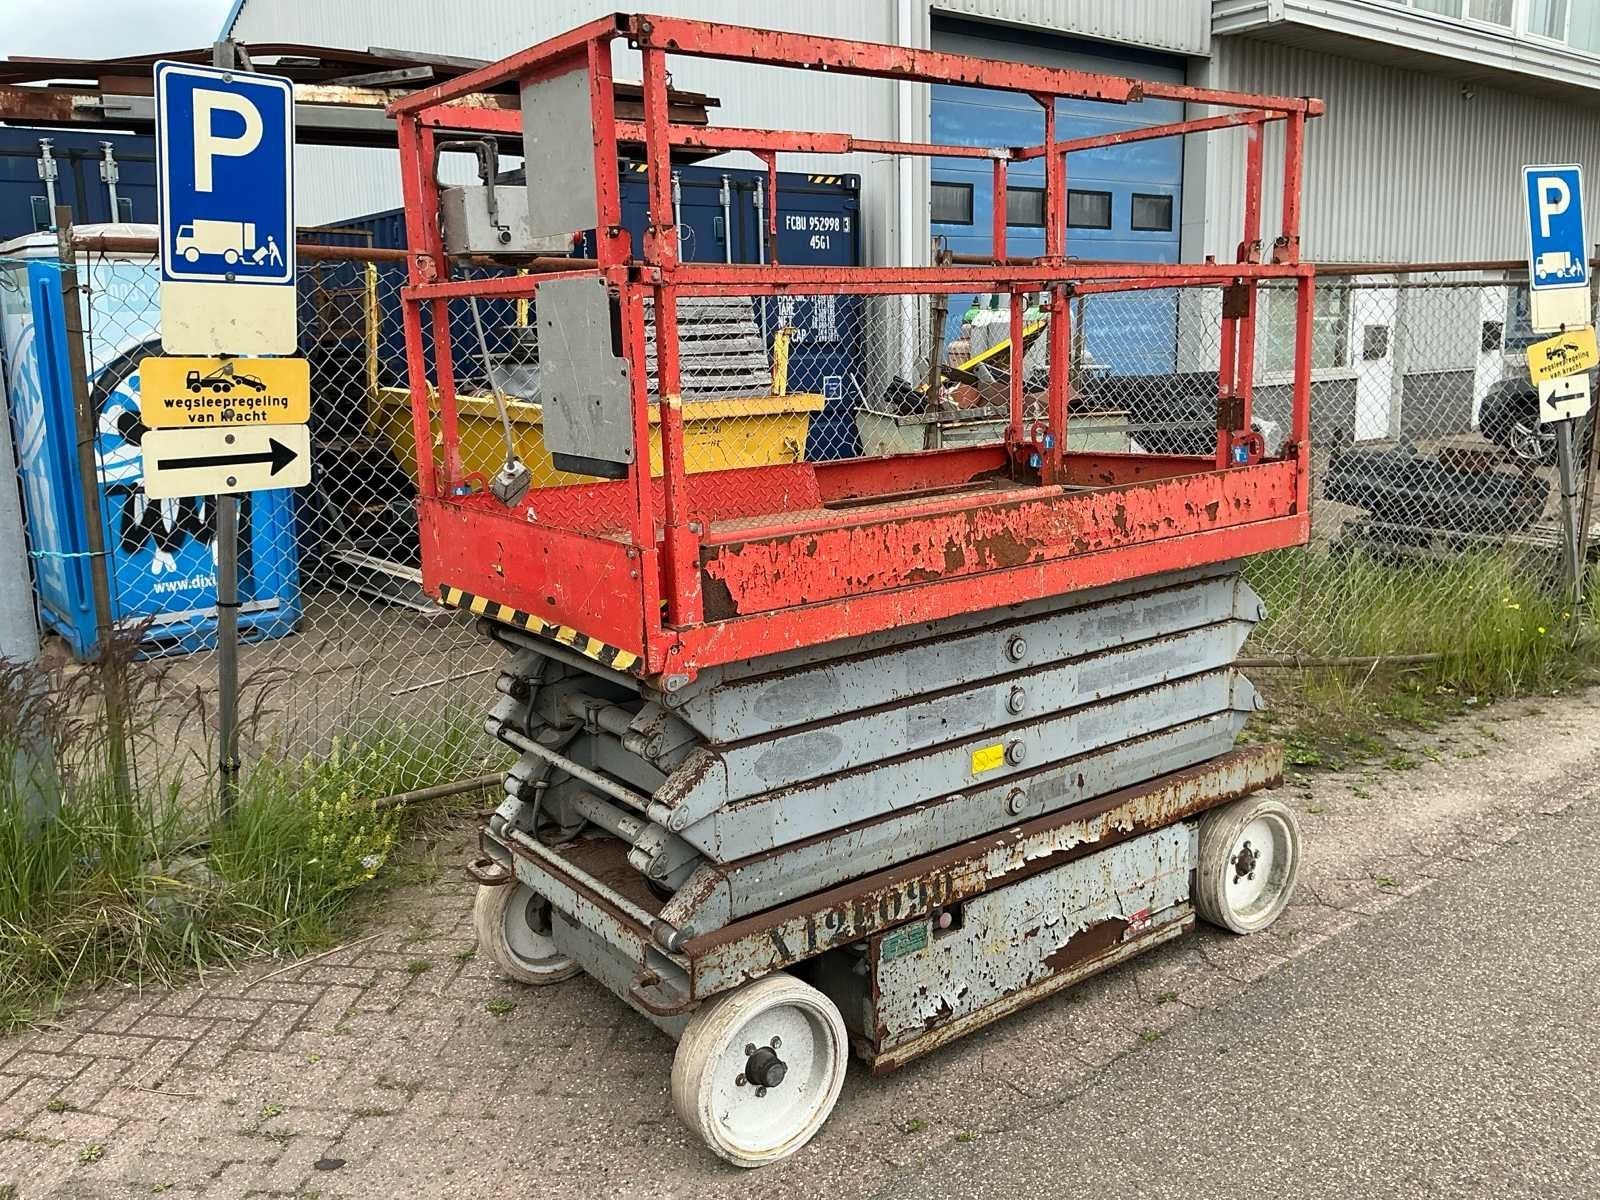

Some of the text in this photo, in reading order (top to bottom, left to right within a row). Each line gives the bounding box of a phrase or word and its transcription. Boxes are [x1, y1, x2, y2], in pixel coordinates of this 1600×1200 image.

[192, 88, 263, 192] P
[1537, 177, 1570, 238] P
[786, 215, 850, 232] FCBU 952998 3
[810, 235, 830, 249] 45G1
[778, 301, 796, 315] TARE
[164, 396, 288, 410] wegsleepregeling
[188, 413, 214, 422] van
[154, 574, 218, 593] www.dixi
